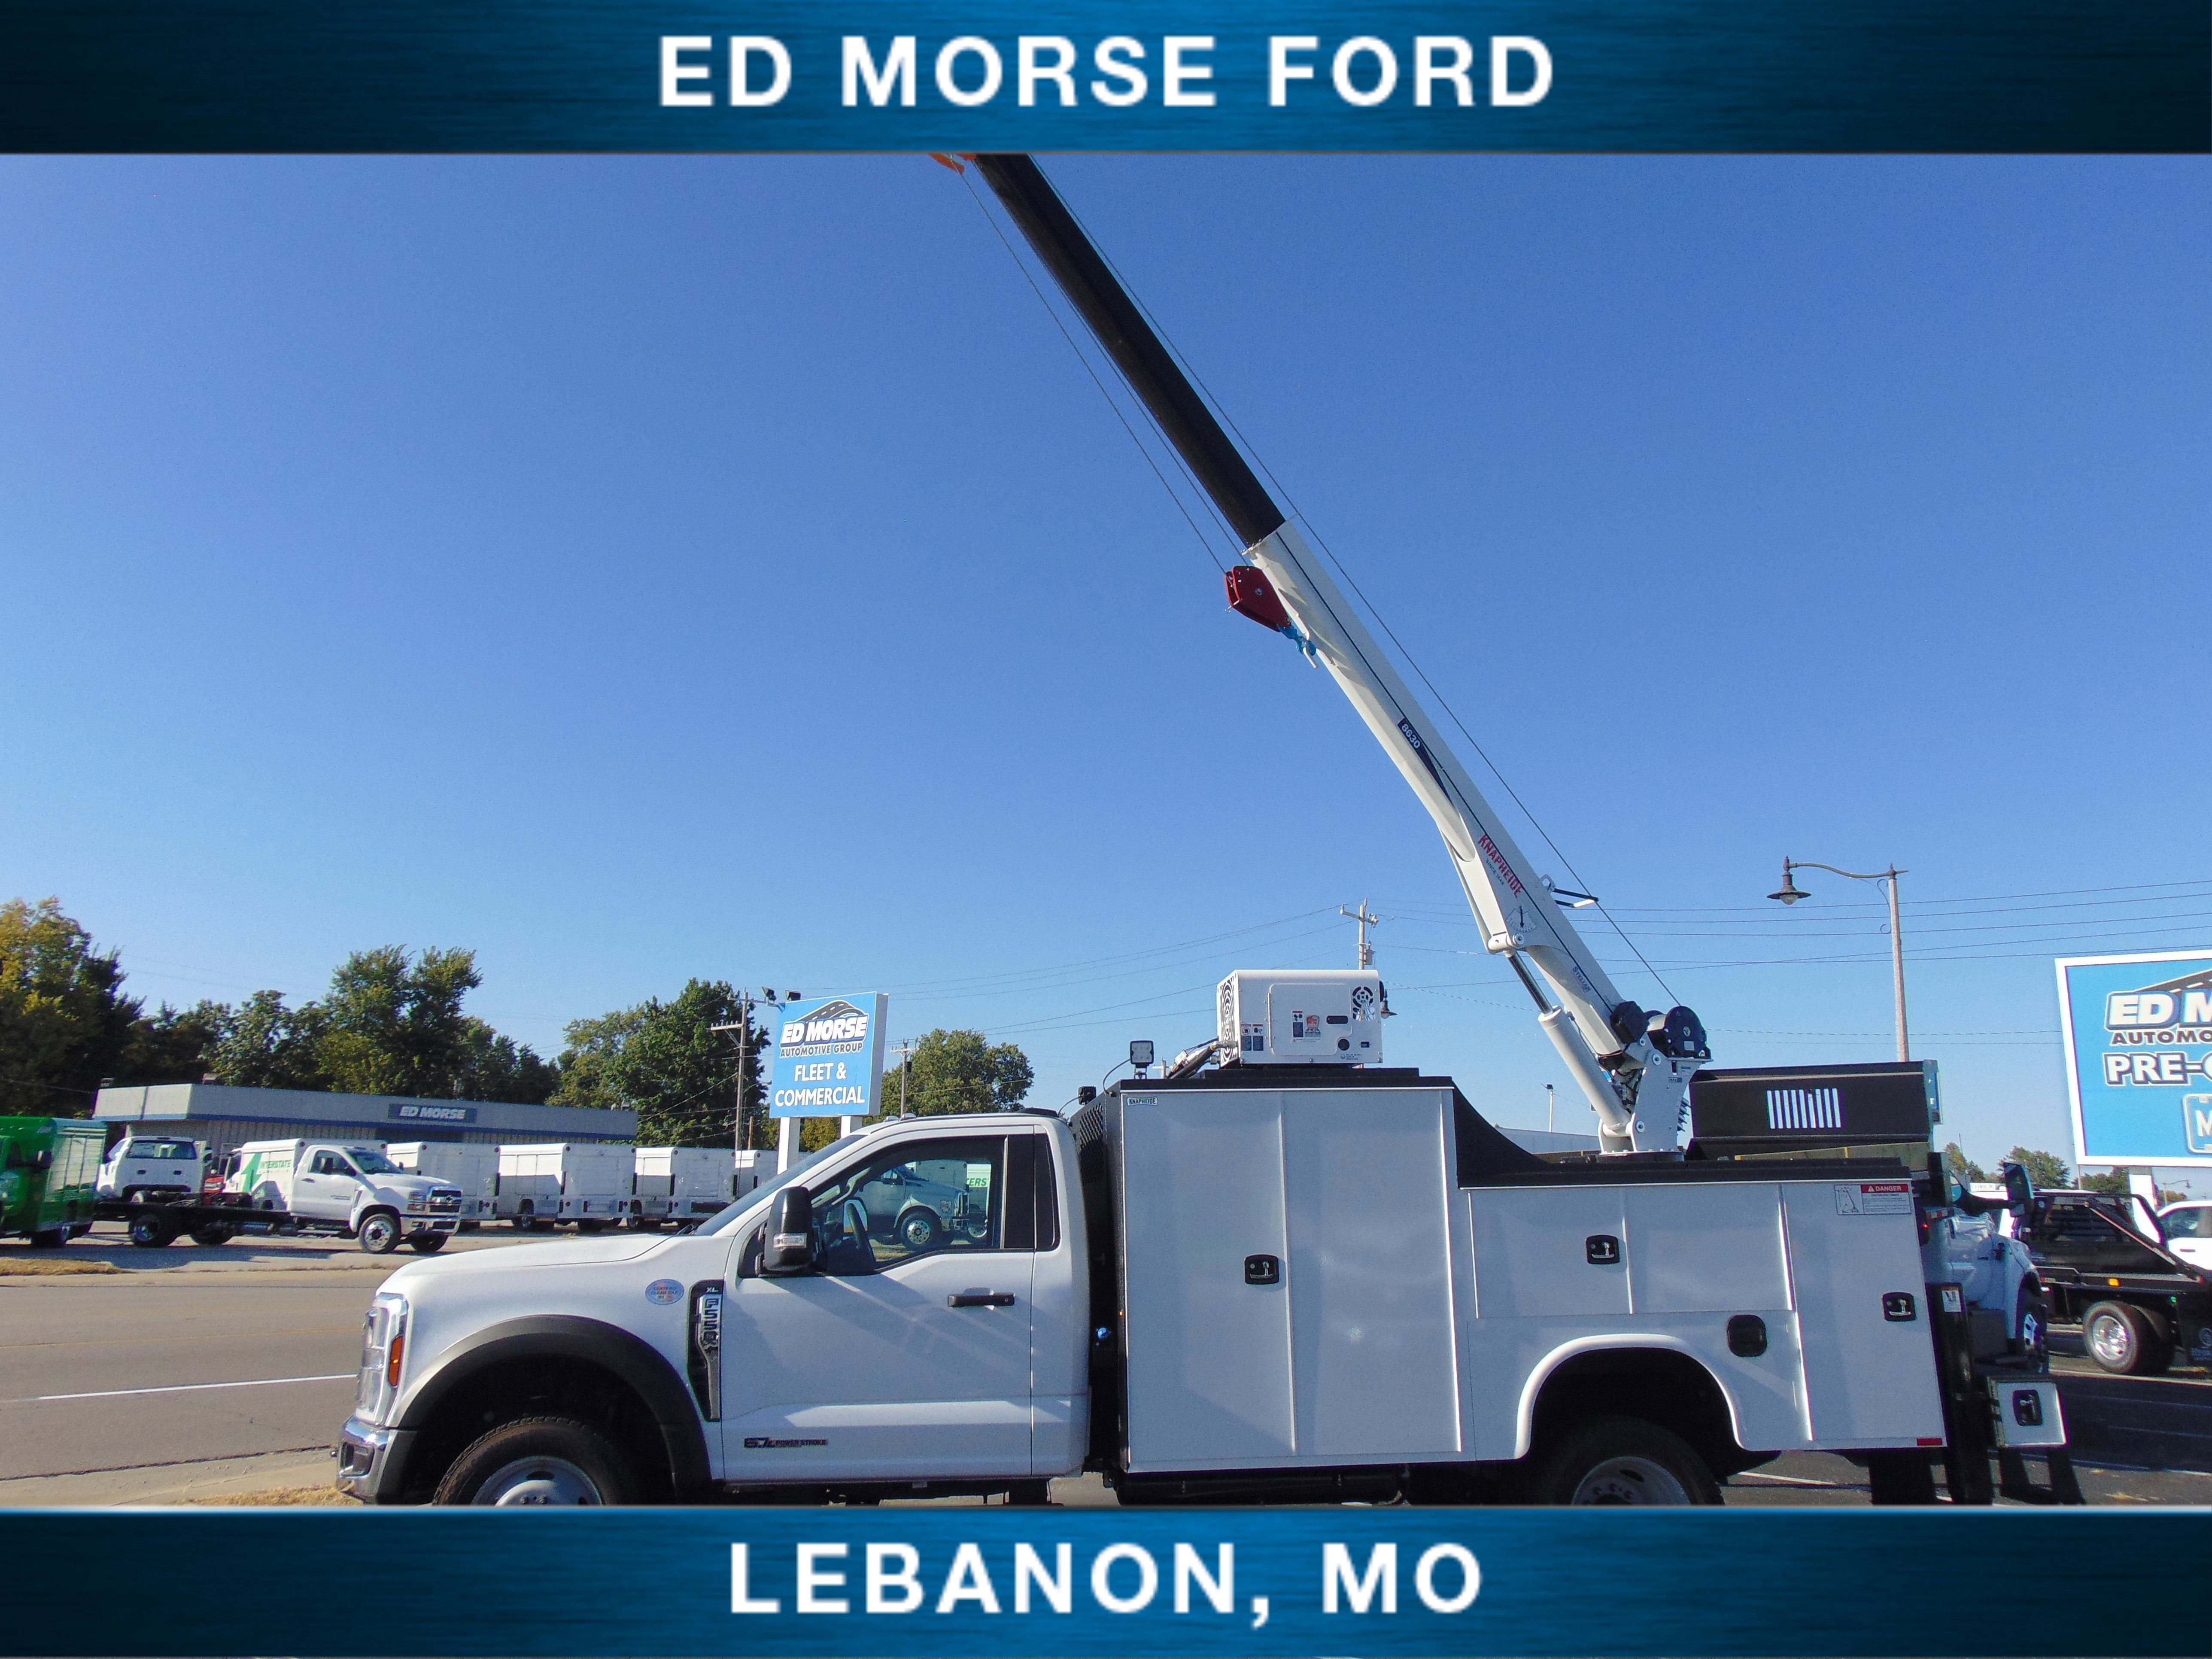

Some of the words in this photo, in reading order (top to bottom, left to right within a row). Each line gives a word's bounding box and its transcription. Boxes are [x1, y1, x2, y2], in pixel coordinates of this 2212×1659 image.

[1401, 723, 1420, 748] 8630
[1478, 834, 1523, 899] KNAPHEIDE
[1486, 860, 1497, 874] SINCE
[2109, 992, 2174, 1026] ED
[781, 1022, 805, 1044] ED
[805, 1016, 868, 1043] MORSE
[780, 1045, 830, 1057] AUTOMOTIVE
[834, 1042, 863, 1053] GROUP
[794, 1062, 834, 1082] FLEET
[836, 1062, 847, 1079] &
[775, 1086, 865, 1107] COMMERCIAL
[399, 1106, 419, 1116] ED
[419, 1107, 467, 1120] MORSE
